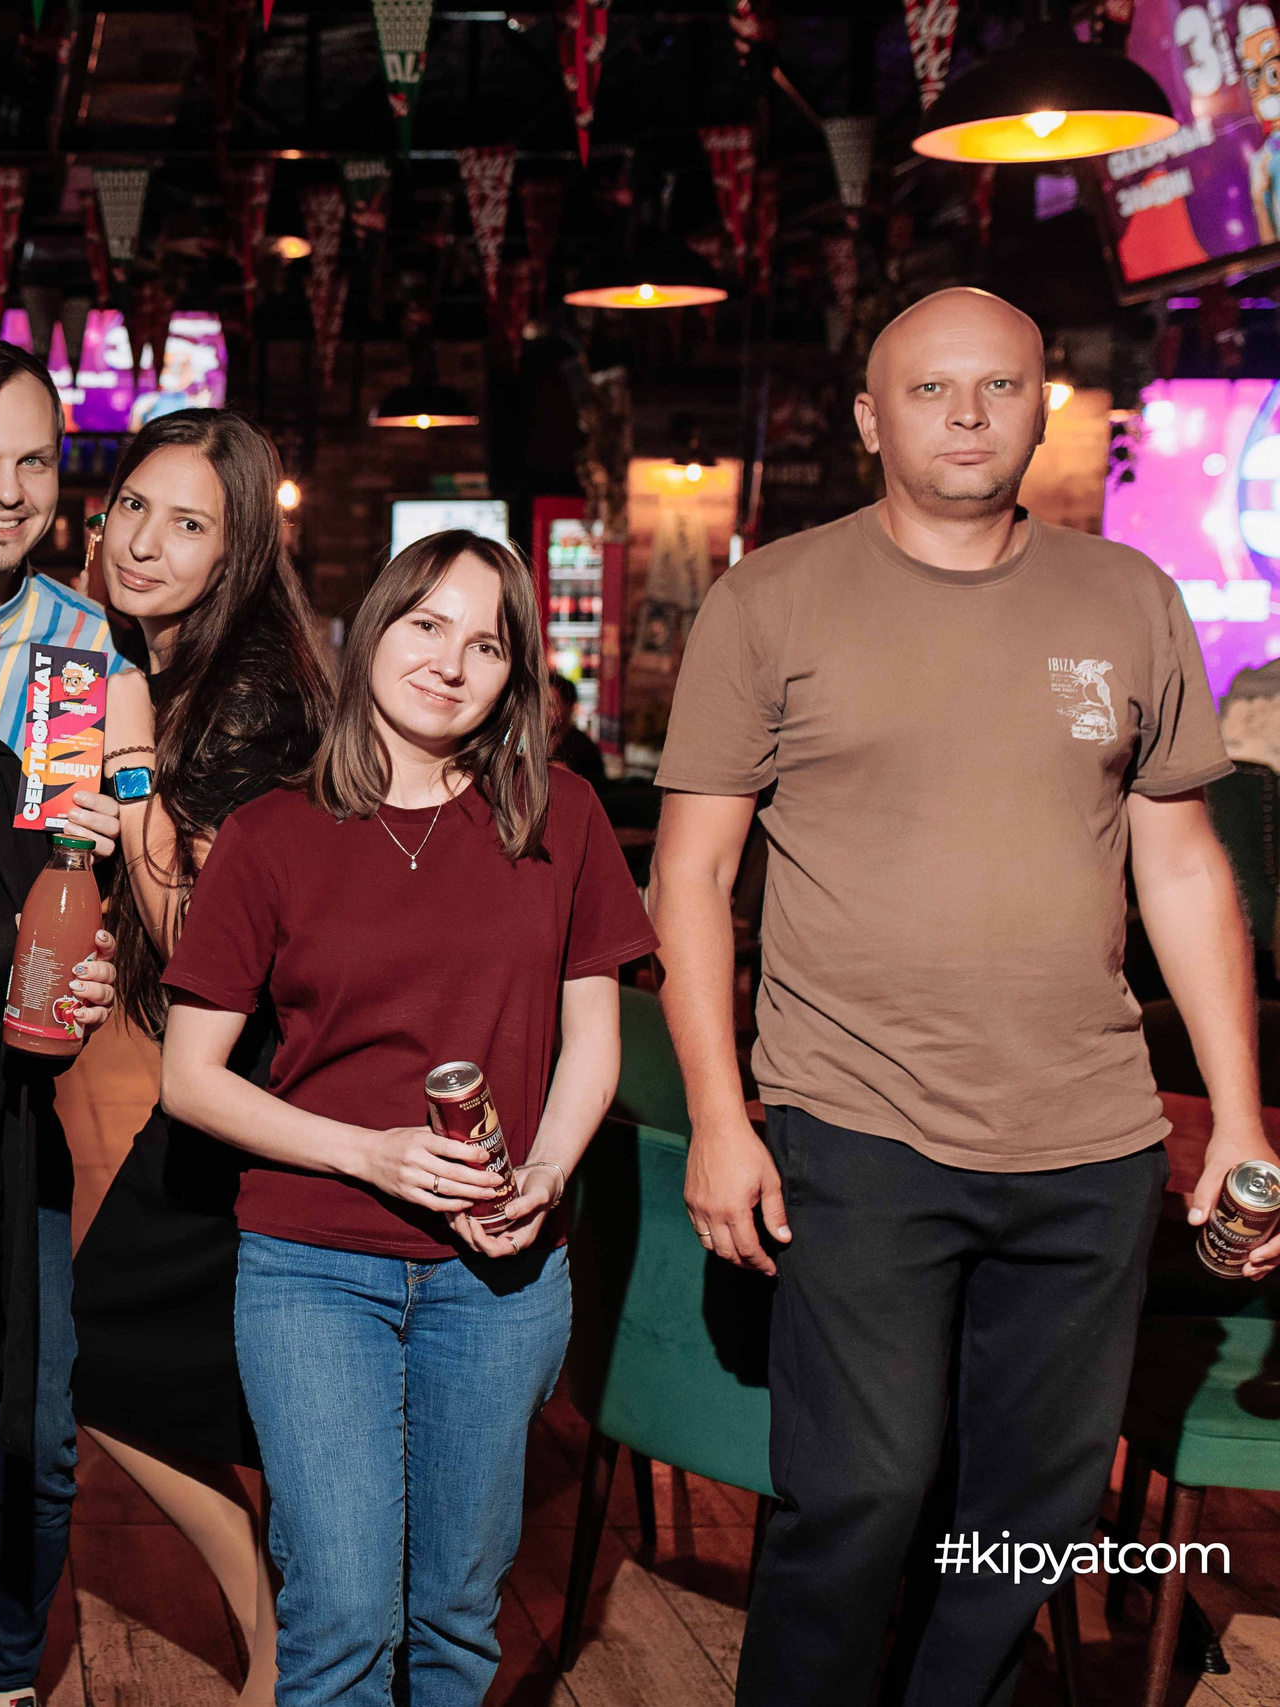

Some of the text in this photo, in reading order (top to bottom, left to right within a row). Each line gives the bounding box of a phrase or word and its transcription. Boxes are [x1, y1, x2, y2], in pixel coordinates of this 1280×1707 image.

[1048, 657, 1076, 672] IBIZA
[23, 652, 52, 821] СЕРТИФИКАТ
[50, 761, 100, 778] ПИЦЦУ
[1208, 1231, 1248, 1254] Pilsner
